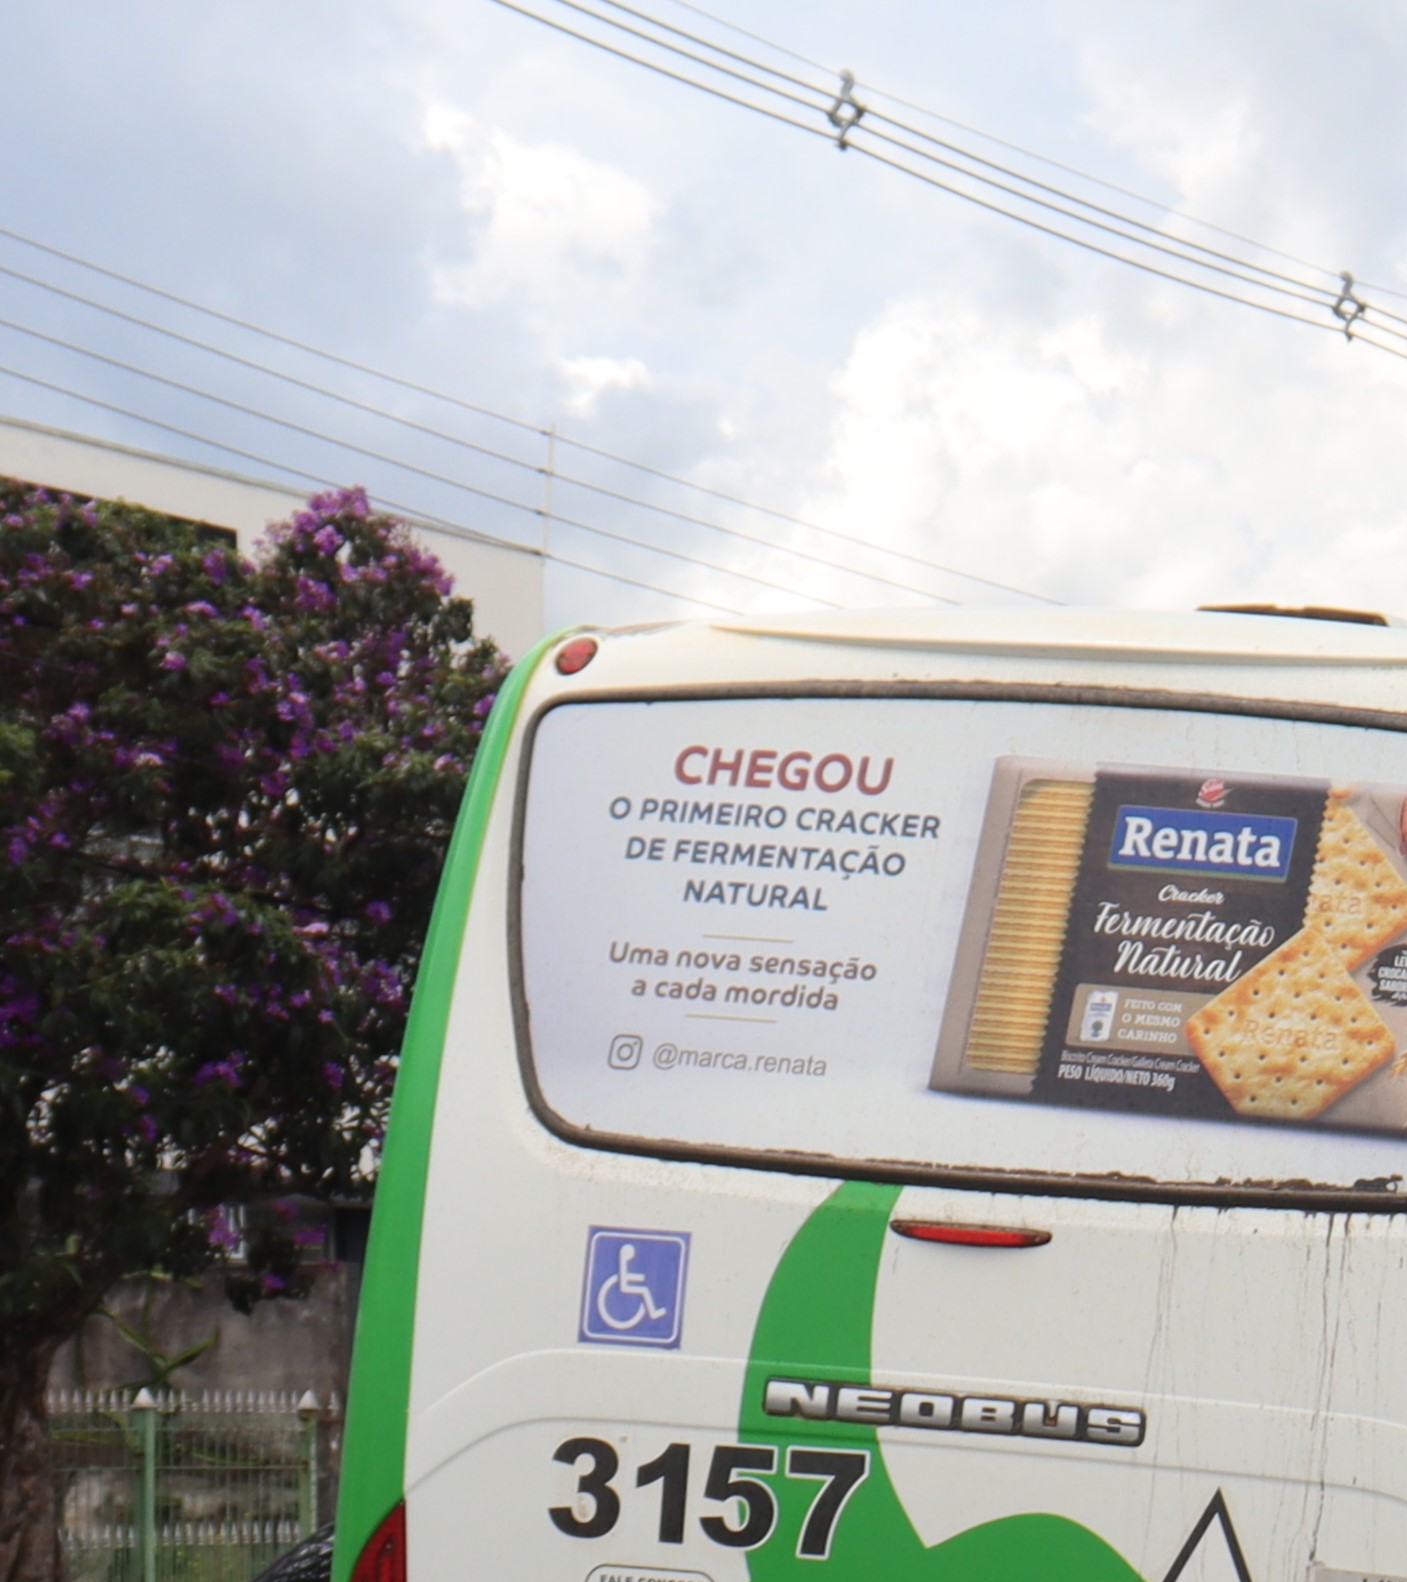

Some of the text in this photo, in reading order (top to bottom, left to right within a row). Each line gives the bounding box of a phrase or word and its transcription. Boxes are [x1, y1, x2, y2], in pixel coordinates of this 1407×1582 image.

[674, 744, 894, 796] CHEGOU
[609, 797, 942, 839] O PRIMEIRO CRACKER
[625, 836, 906, 880] DE FERMENTAÇÃO
[1118, 815, 1282, 868] Renata
[683, 880, 828, 911] NATURAL
[1158, 883, 1225, 905] Cracker
[1094, 901, 1276, 951] Fermentação
[609, 941, 877, 985] Uma nova sensação
[1113, 939, 1243, 983] Natural
[631, 976, 839, 1011] a cada mordida
[1124, 998, 1155, 1011] FEITO
[1157, 1001, 1183, 1012] COM
[1117, 1028, 1178, 1044] CARINHO
[1121, 1013, 1181, 1027] O MESMO
[652, 1042, 827, 1077] @marca.renata
[1058, 1064, 1082, 1079] PESO
[1150, 1072, 1176, 1092] 360g
[766, 1379, 1143, 1444] NEOBUS
[548, 1437, 870, 1560] 3157
